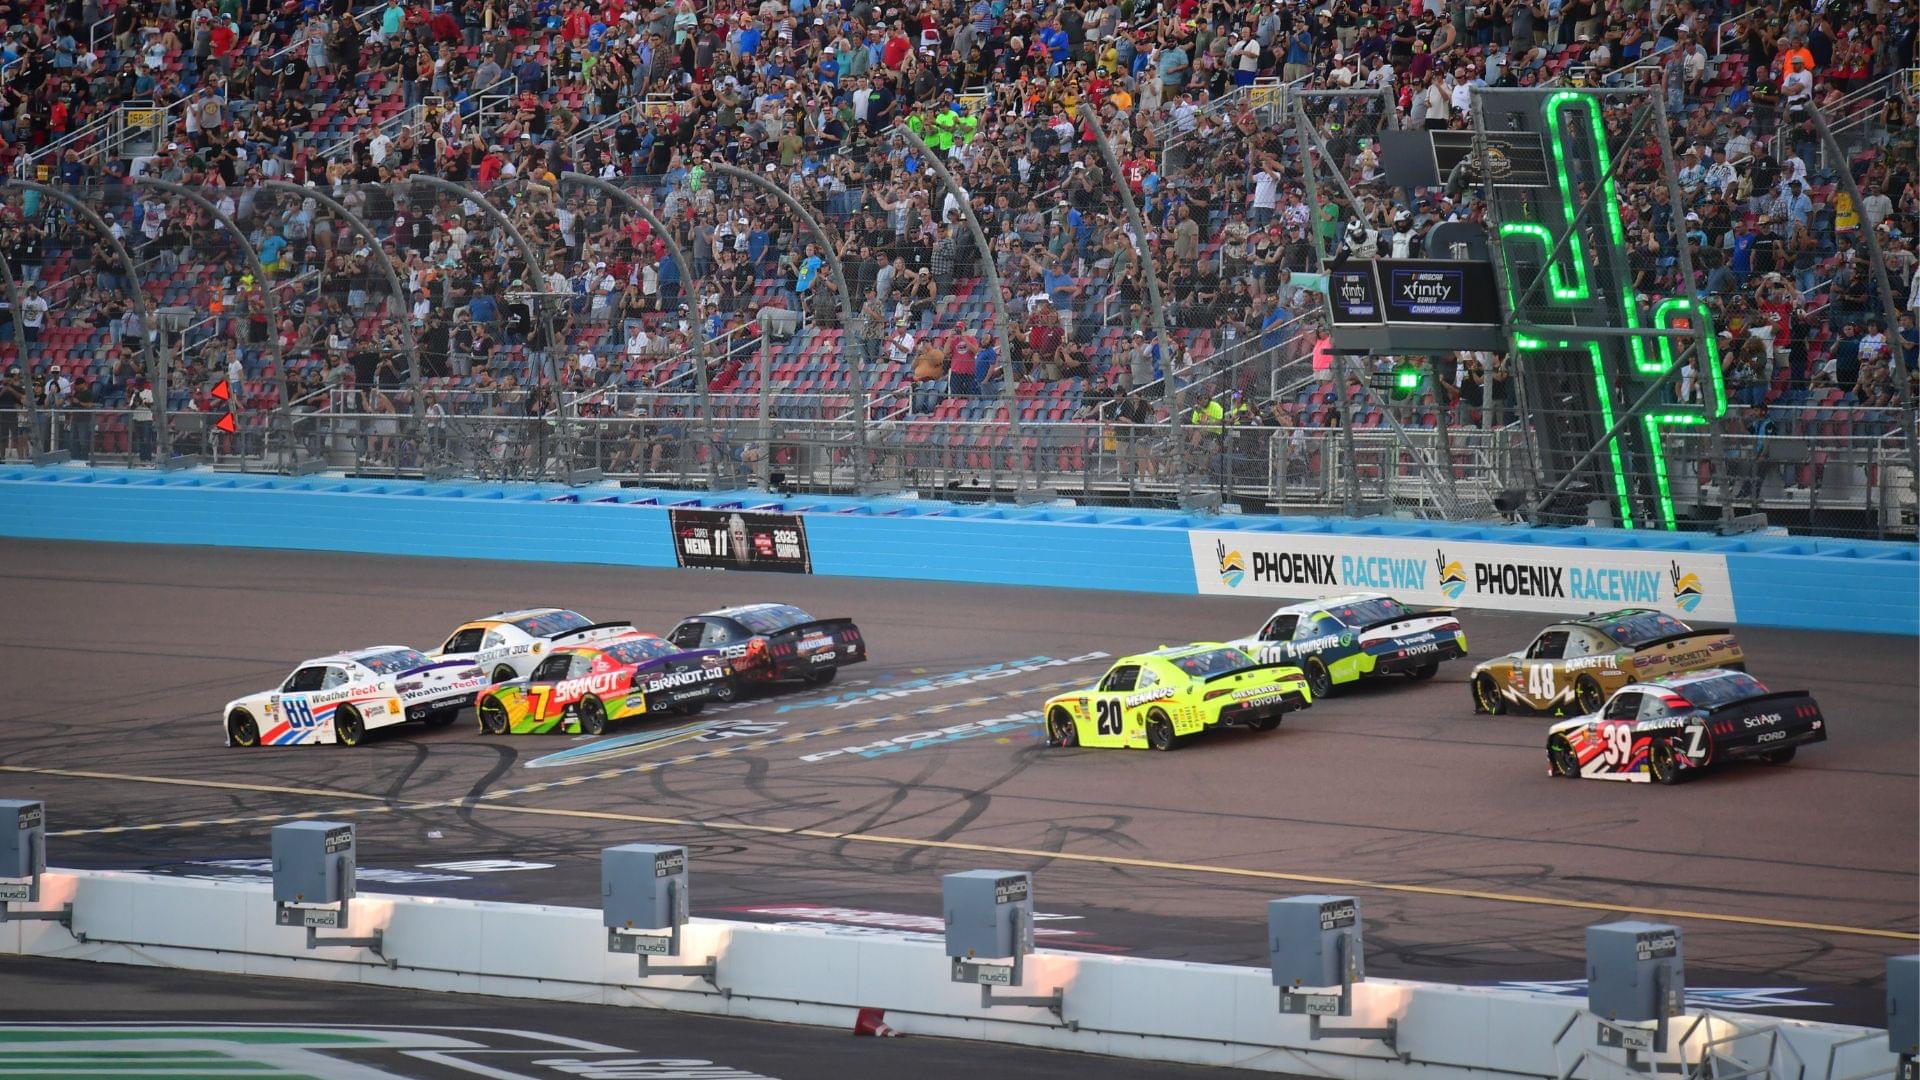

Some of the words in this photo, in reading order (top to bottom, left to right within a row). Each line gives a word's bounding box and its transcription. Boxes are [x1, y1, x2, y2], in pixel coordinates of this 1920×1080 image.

[1341, 281, 1365, 300] xfinity
[1403, 282, 1452, 300] xfinity
[1411, 306, 1461, 314] CHAMPIONSHIP
[714, 529, 728, 556] 11
[774, 530, 798, 544] 2025
[684, 538, 712, 556] HEIM
[1252, 551, 1337, 585] PHOENIX
[1341, 554, 1427, 590] RACEWAY
[1475, 563, 1565, 598] PHOENIX
[1569, 567, 1661, 602] RACEWAY
[811, 651, 836, 664] FORD
[1405, 643, 1438, 656] TOYOTA
[406, 679, 478, 699] WeatherTech
[554, 670, 627, 703] BRANDT
[1529, 663, 1555, 699] 48
[312, 684, 376, 703] WeatherTech
[1125, 687, 1174, 710] MENARDS
[1231, 685, 1280, 699] MENARDS
[1249, 695, 1283, 707] TOYOTA
[282, 697, 316, 728] 88
[531, 685, 552, 722] 7
[1096, 697, 1123, 735] 20
[1603, 724, 1632, 765] 39
[1758, 730, 1786, 743] FORD
